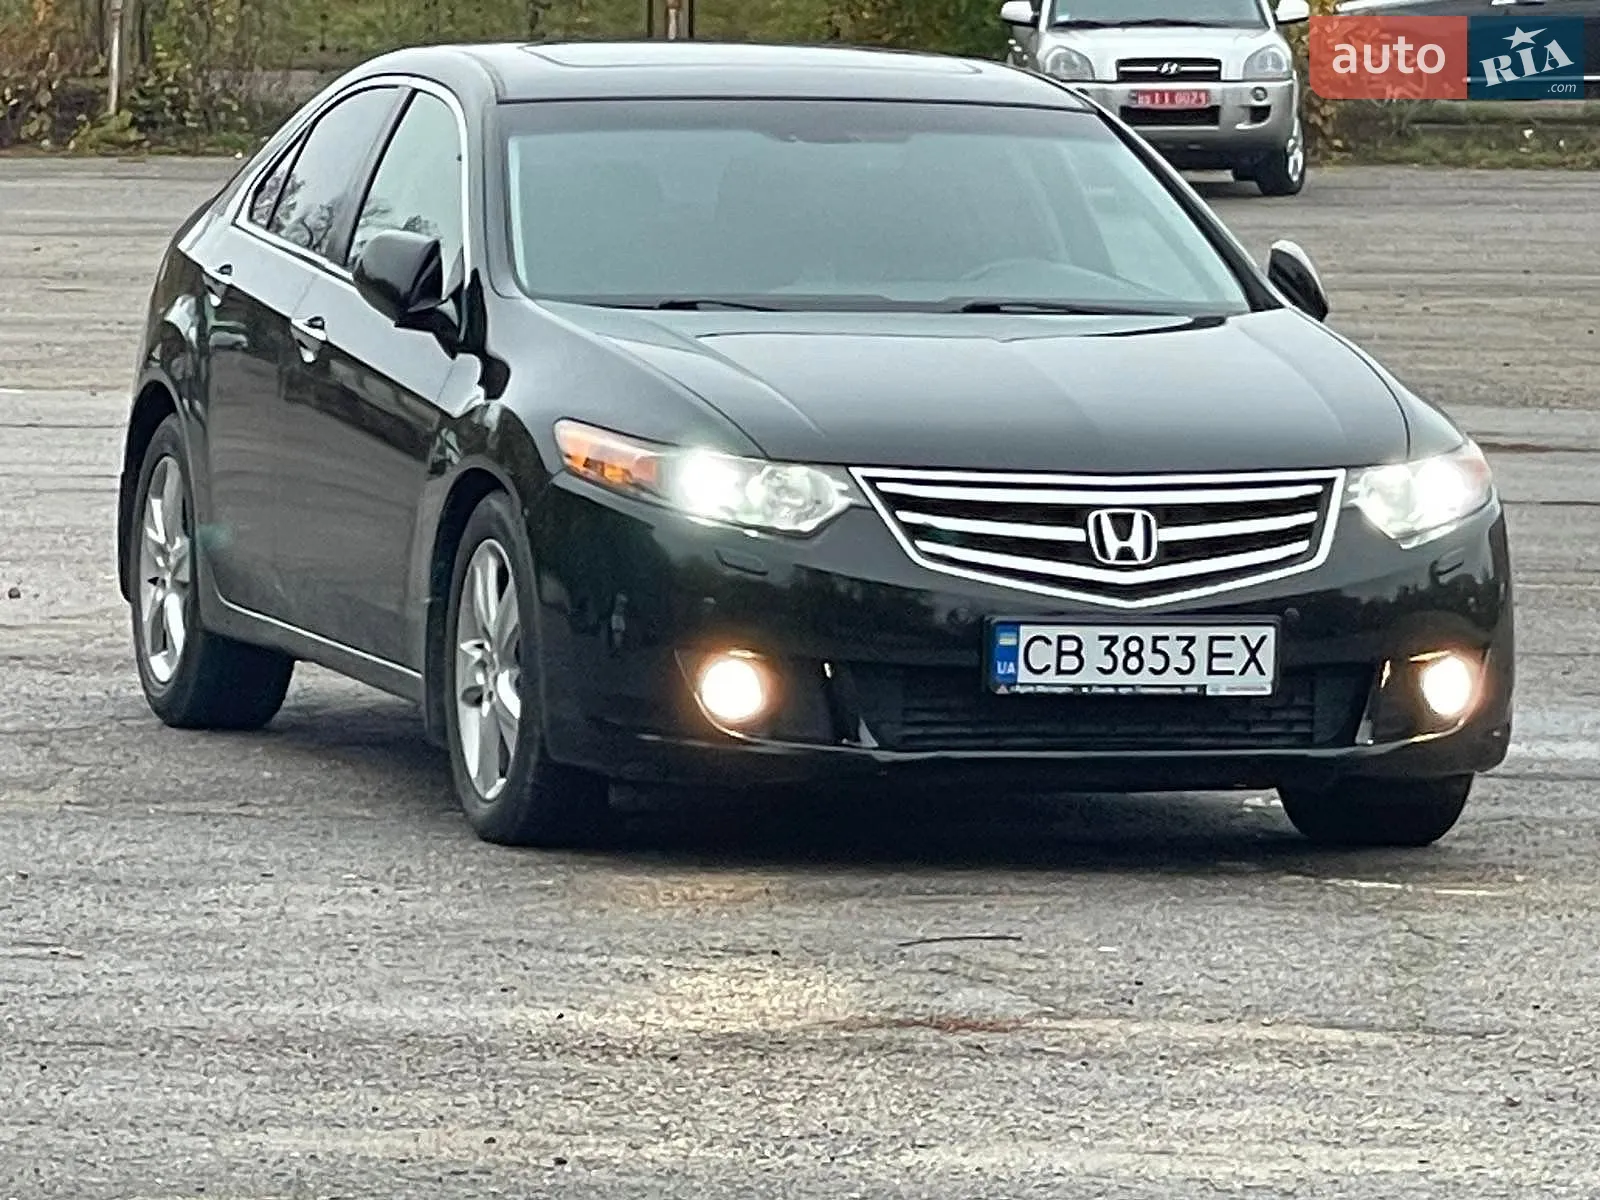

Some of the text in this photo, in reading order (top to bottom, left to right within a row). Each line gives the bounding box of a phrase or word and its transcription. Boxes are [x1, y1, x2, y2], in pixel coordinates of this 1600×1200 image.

[996, 661, 1016, 674] UA
[1023, 634, 1268, 676] CB 3853 EX
